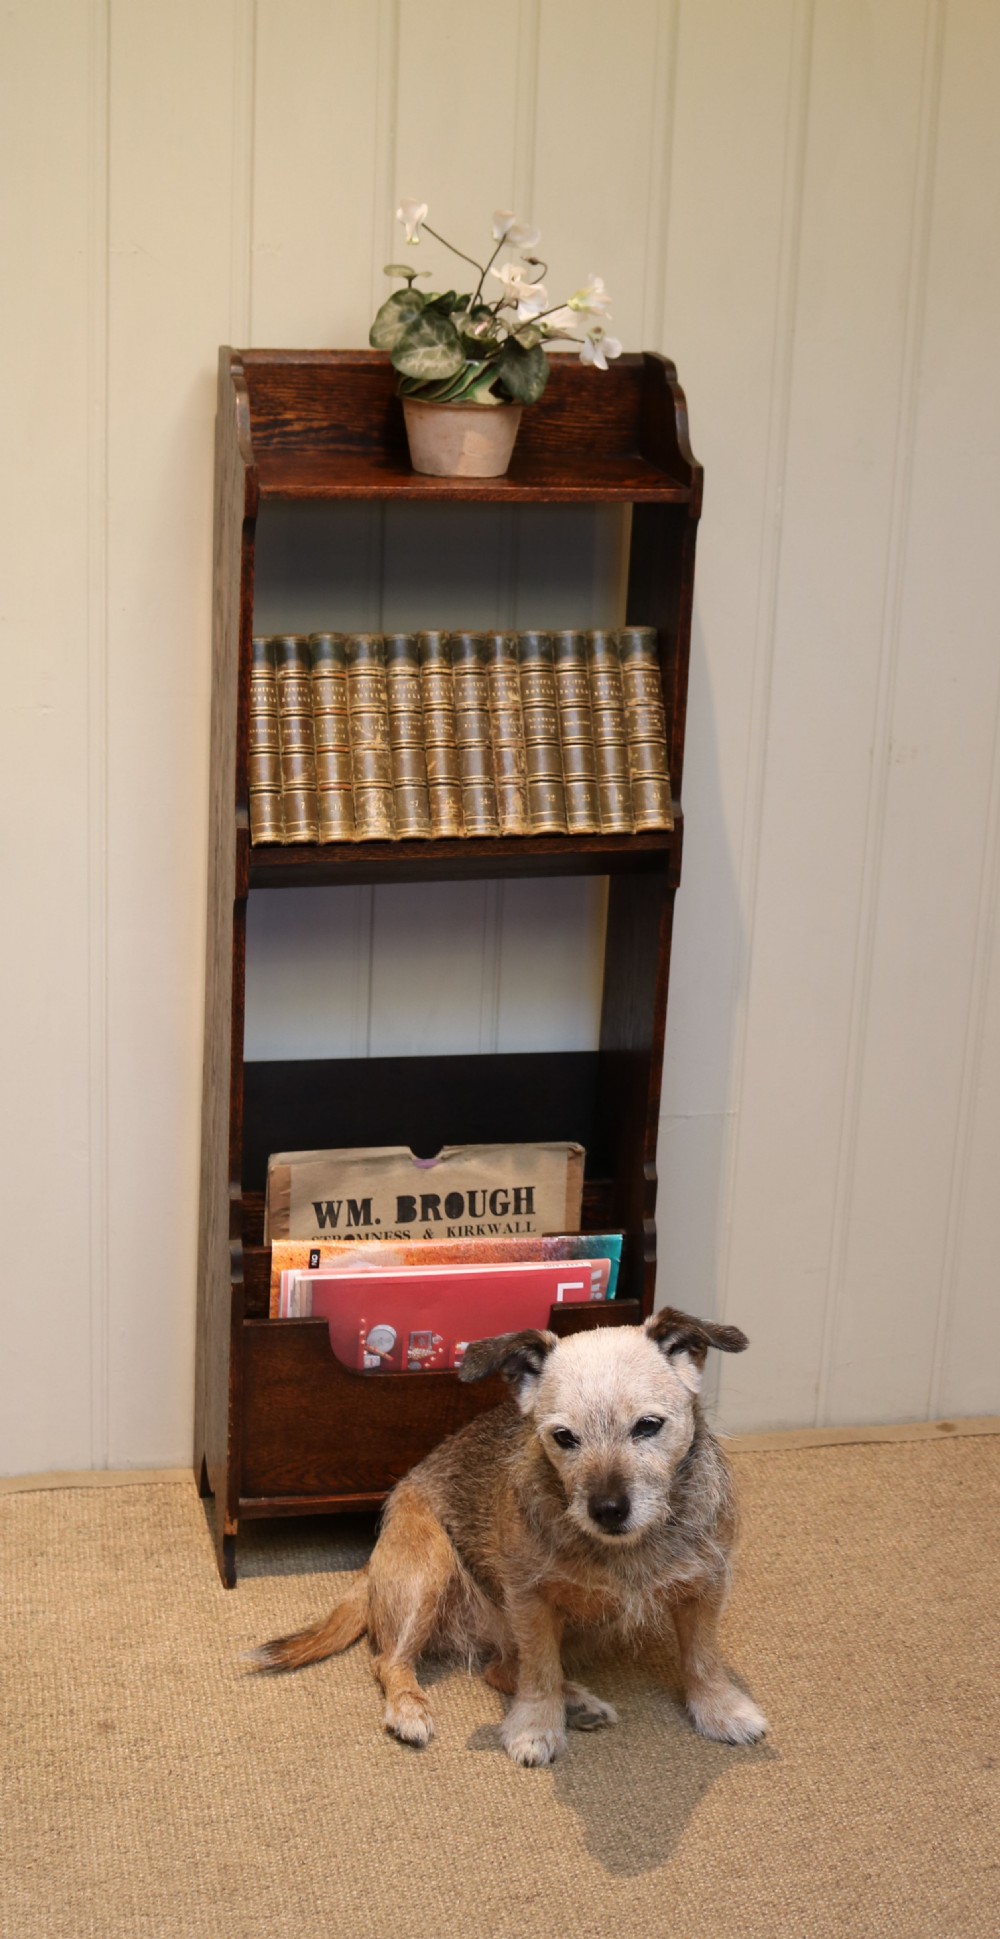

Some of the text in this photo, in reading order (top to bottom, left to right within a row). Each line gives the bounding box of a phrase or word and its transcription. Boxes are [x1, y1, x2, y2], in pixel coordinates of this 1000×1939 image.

[312, 1186, 536, 1229] WM. BROUGH
[422, 1228, 434, 1240] &
[447, 1221, 537, 1238] KIRKWALL
